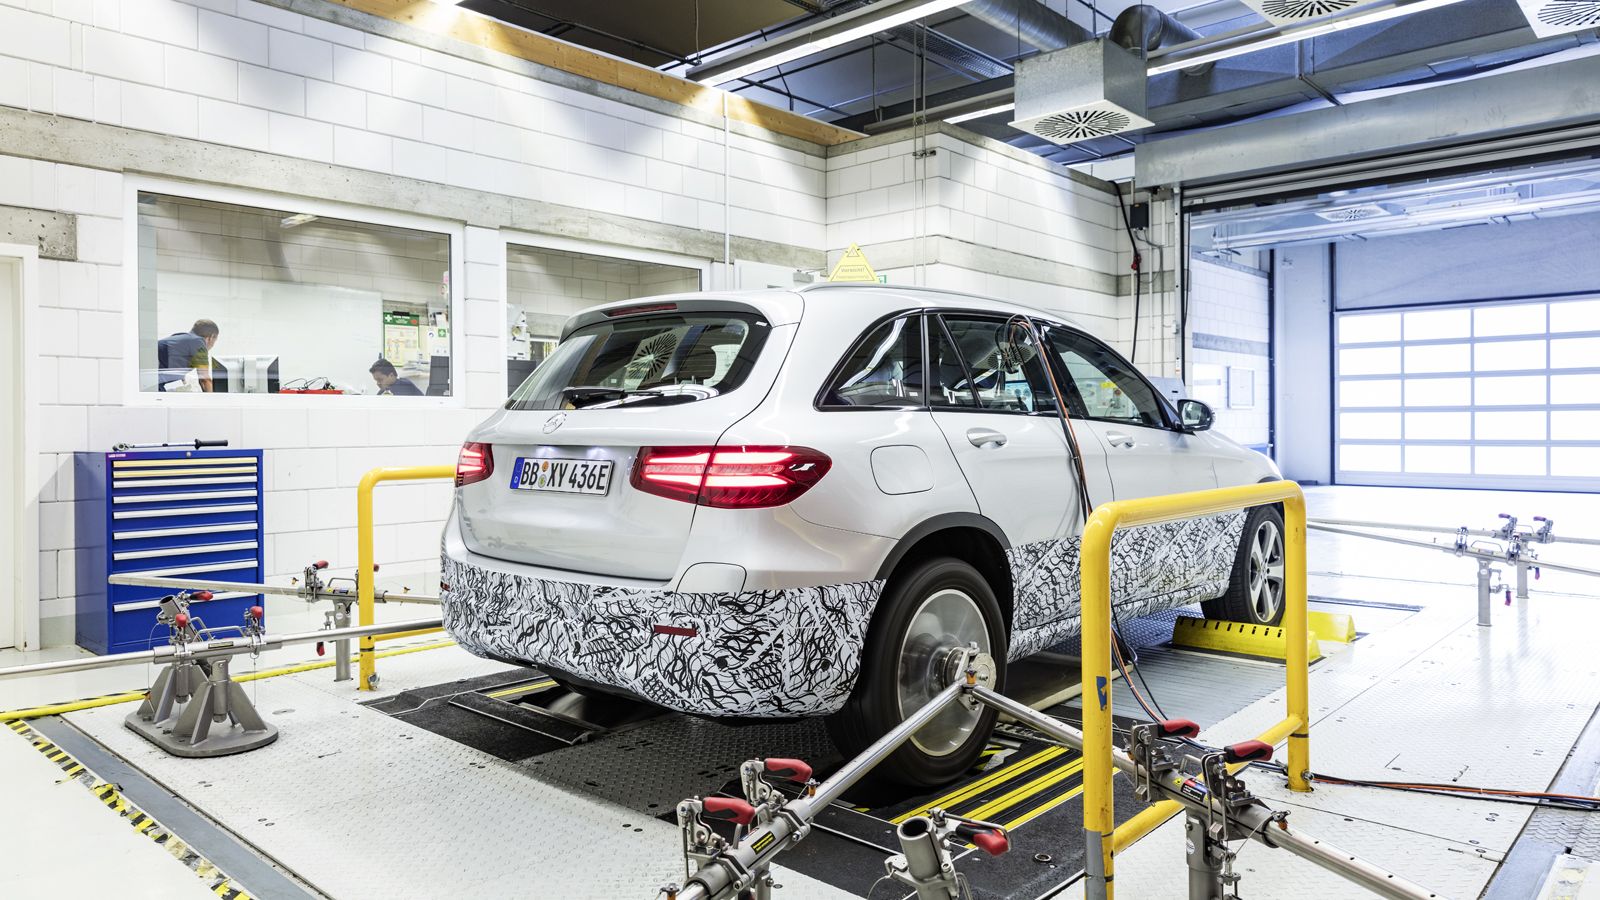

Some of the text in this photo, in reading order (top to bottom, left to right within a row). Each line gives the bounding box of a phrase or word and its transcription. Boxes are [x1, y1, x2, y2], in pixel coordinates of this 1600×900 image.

[520, 461, 609, 490] BB XY 436E
